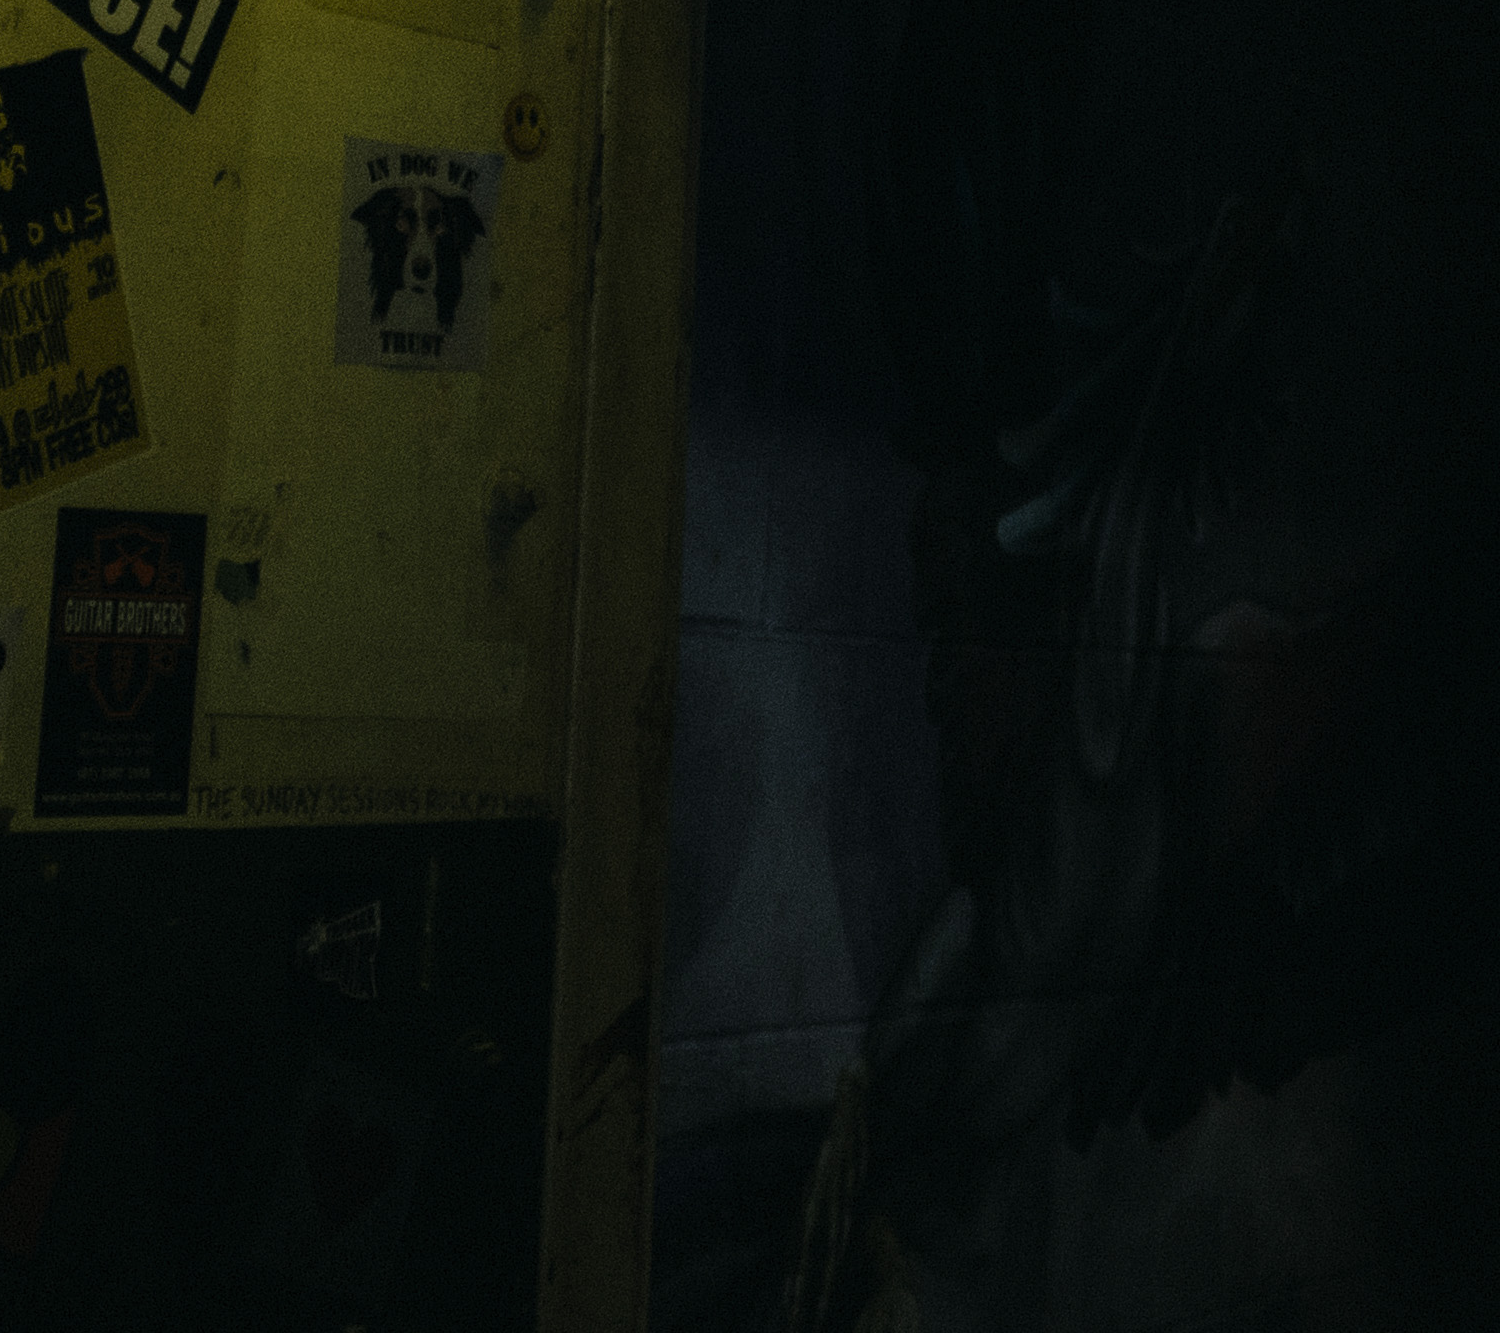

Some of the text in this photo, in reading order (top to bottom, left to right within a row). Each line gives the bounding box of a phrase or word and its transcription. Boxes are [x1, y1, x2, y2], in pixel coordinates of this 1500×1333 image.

[366, 153, 480, 192] IN DOG WE
[379, 330, 445, 357] TRUST
[63, 596, 187, 637] GUITAR BROTHERS
